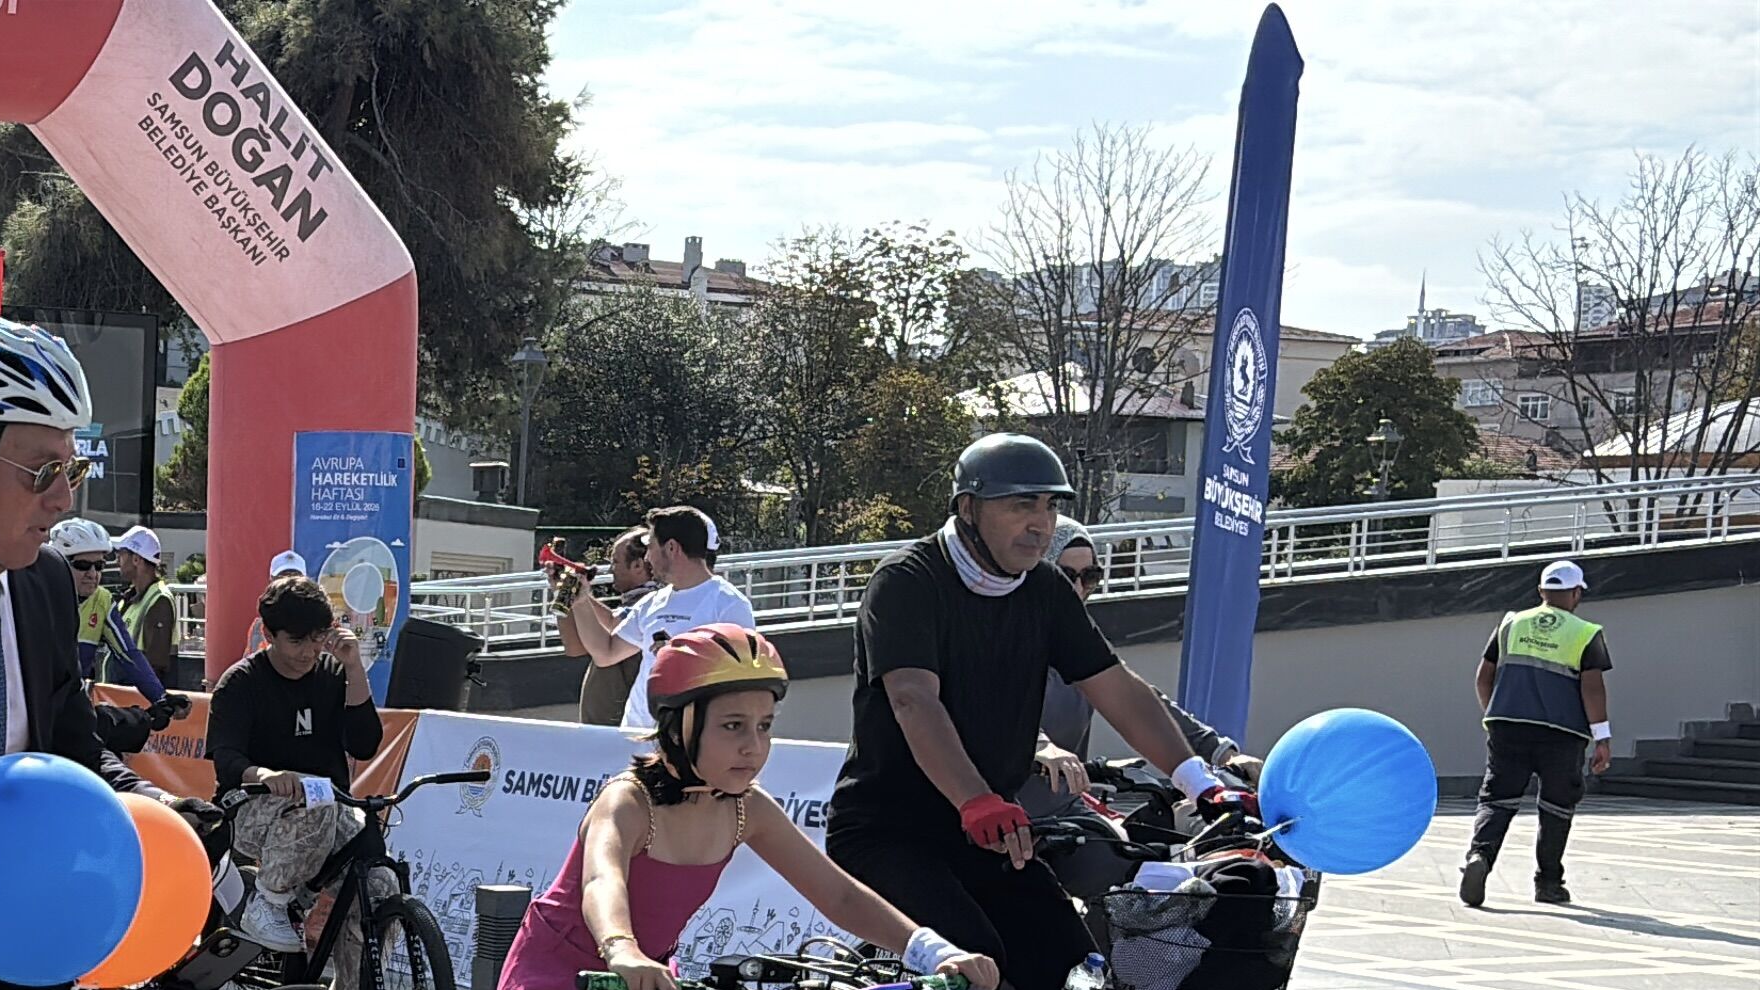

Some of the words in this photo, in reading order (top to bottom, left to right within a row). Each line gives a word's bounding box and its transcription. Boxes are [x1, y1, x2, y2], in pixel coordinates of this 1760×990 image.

[214, 38, 333, 182] HALİT
[168, 51, 328, 243] DOĞAN
[138, 115, 209, 196] BELEDİYE
[203, 195, 267, 266] BAŞKANI
[147, 92, 208, 163] SAMSUN
[203, 160, 290, 263] BÜYÜKŞEHİR
[311, 457, 365, 470] AVRUPA
[311, 471, 398, 487] HAREKETLİLİK
[311, 488, 364, 501] HAFTASI
[1203, 474, 1263, 524] BÜYÜKŞEHİR
[502, 769, 581, 802] SAMSUN
